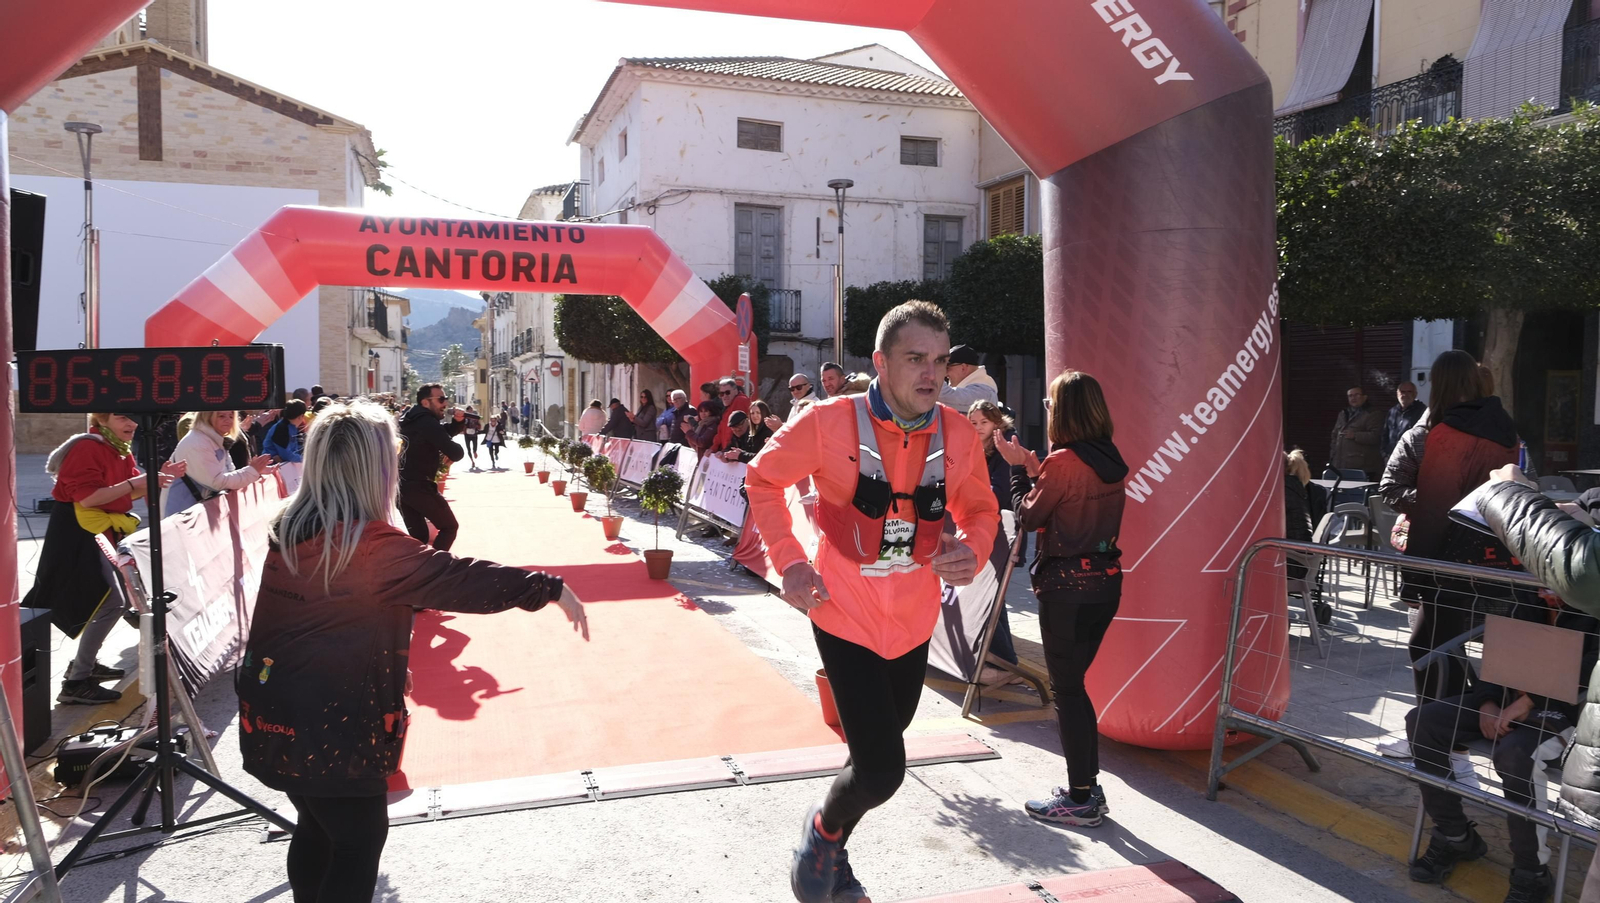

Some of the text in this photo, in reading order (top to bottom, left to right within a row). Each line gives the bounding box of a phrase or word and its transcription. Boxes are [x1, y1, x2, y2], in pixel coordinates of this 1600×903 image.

[359, 215, 585, 244] AYUNTAMIENTO
[366, 244, 578, 284] CANTORIA
[1125, 282, 1280, 504] www.teamergy.es
[262, 722, 296, 736] VEOLIA
